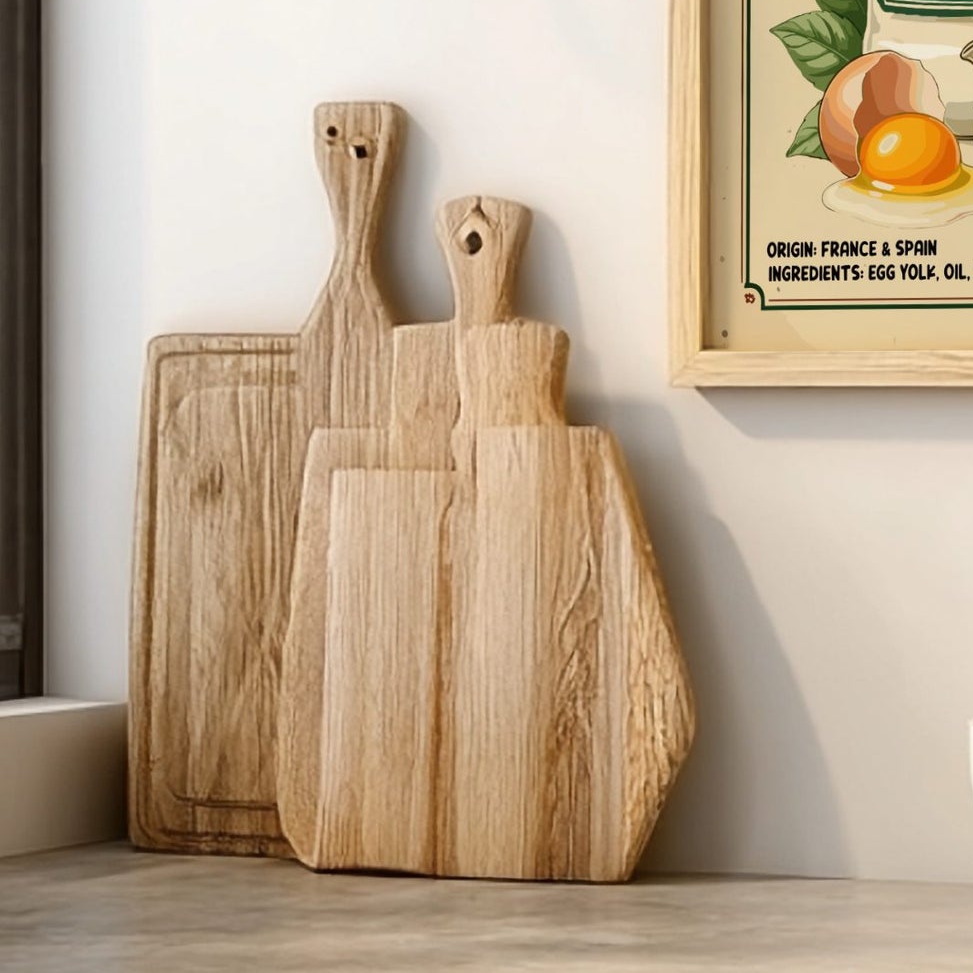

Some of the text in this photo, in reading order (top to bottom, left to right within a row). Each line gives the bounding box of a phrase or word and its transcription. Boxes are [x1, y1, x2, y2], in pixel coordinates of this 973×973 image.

[767, 239, 937, 258] ORIGIN: FRANCE & SPAIN
[768, 264, 864, 282] INGREDIENTS:
[868, 264, 896, 281] EGG
[900, 263, 939, 282] YOLK,
[944, 263, 971, 281] OIL,
